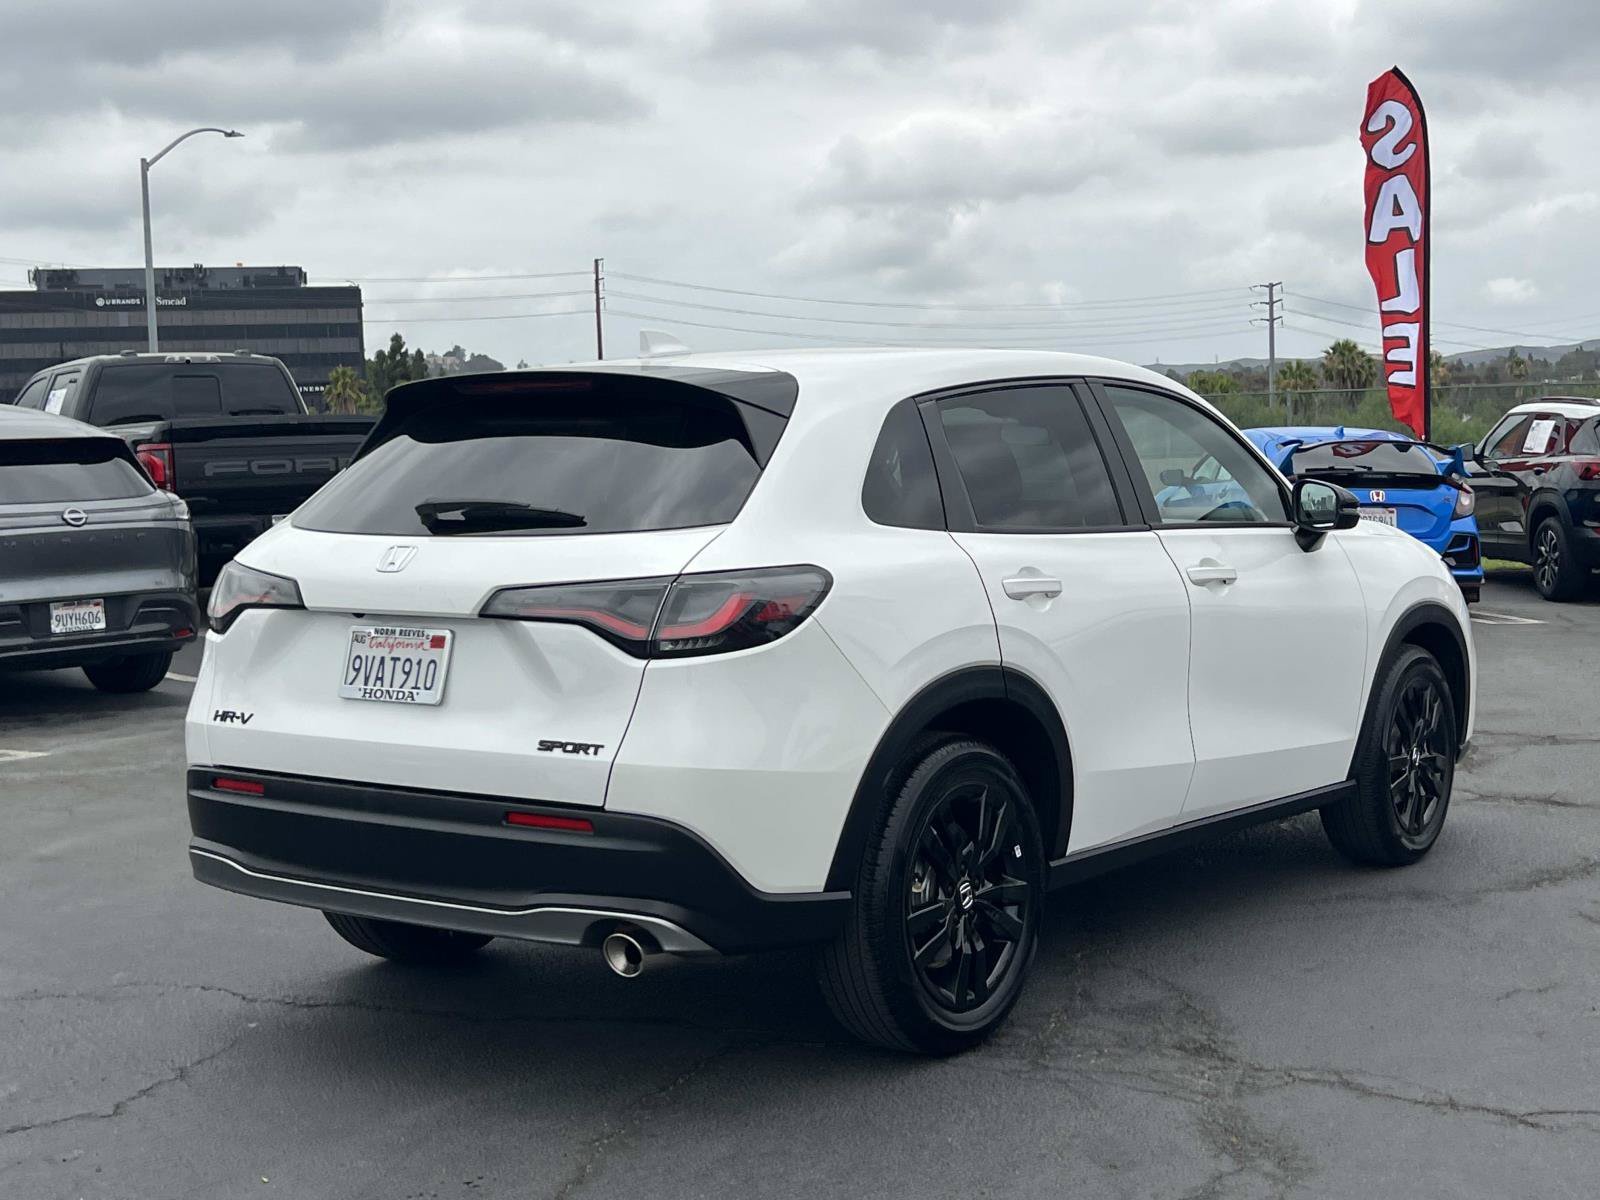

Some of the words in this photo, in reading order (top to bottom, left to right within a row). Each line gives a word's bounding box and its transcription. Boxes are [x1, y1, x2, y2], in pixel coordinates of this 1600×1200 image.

[156, 296, 187, 306] Smead
[55, 611, 101, 627] 9UYH606
[374, 628, 396, 636] NORM
[399, 629, 425, 638] REEVES
[349, 654, 437, 691] 9VAT910
[362, 688, 416, 701] HONDA
[213, 709, 254, 725] HR-V
[537, 739, 605, 756] SPORT
